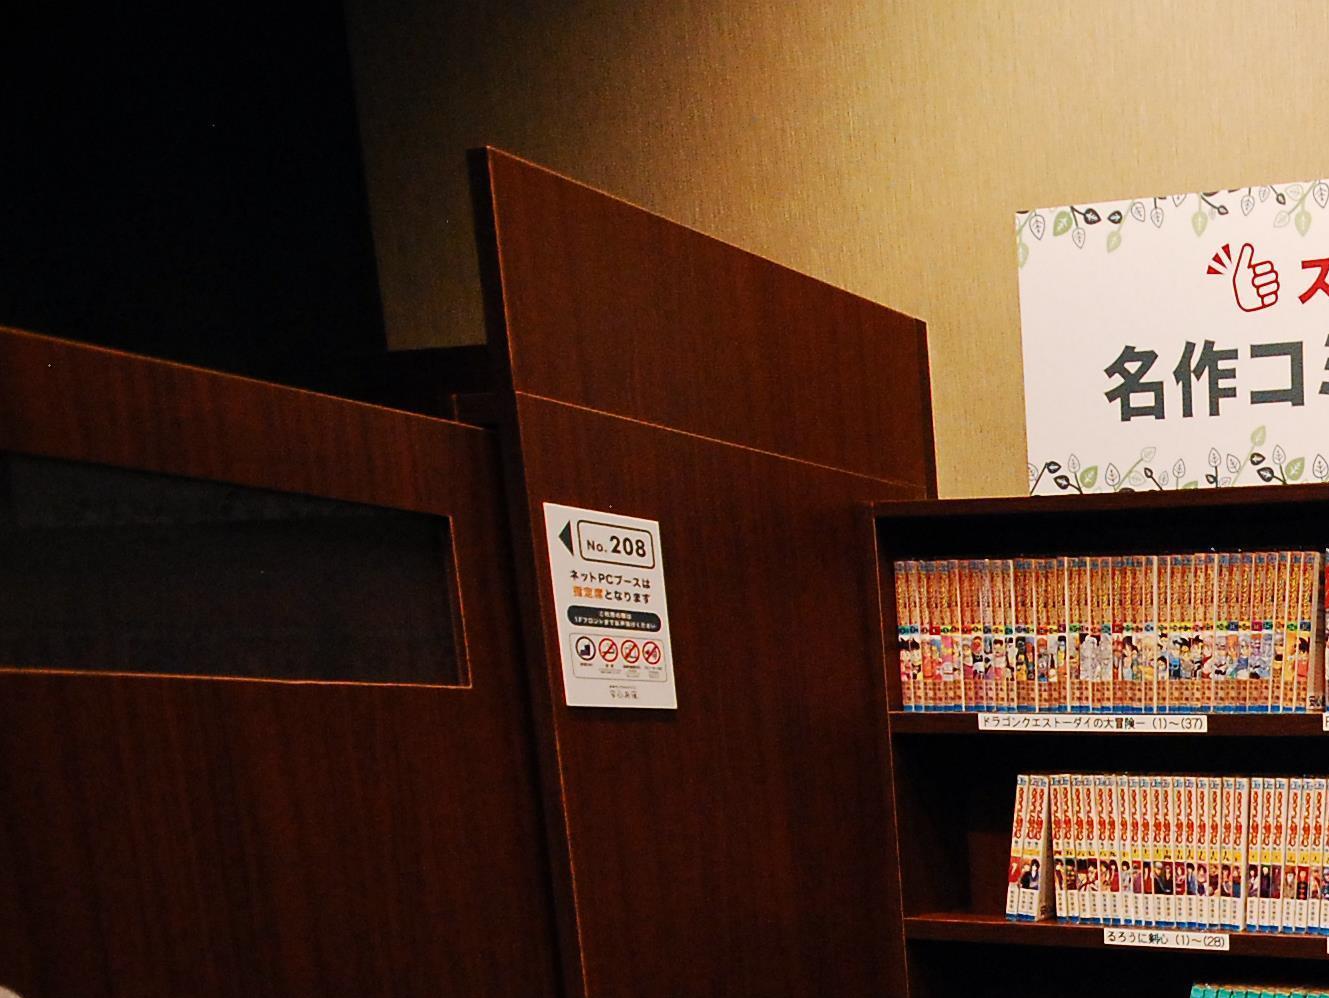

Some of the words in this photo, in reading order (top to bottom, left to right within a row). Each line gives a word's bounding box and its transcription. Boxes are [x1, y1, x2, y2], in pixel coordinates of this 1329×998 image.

[587, 539, 608, 554] No.
[609, 535, 647, 558] 208
[570, 570, 651, 589] ネットPCブースは
